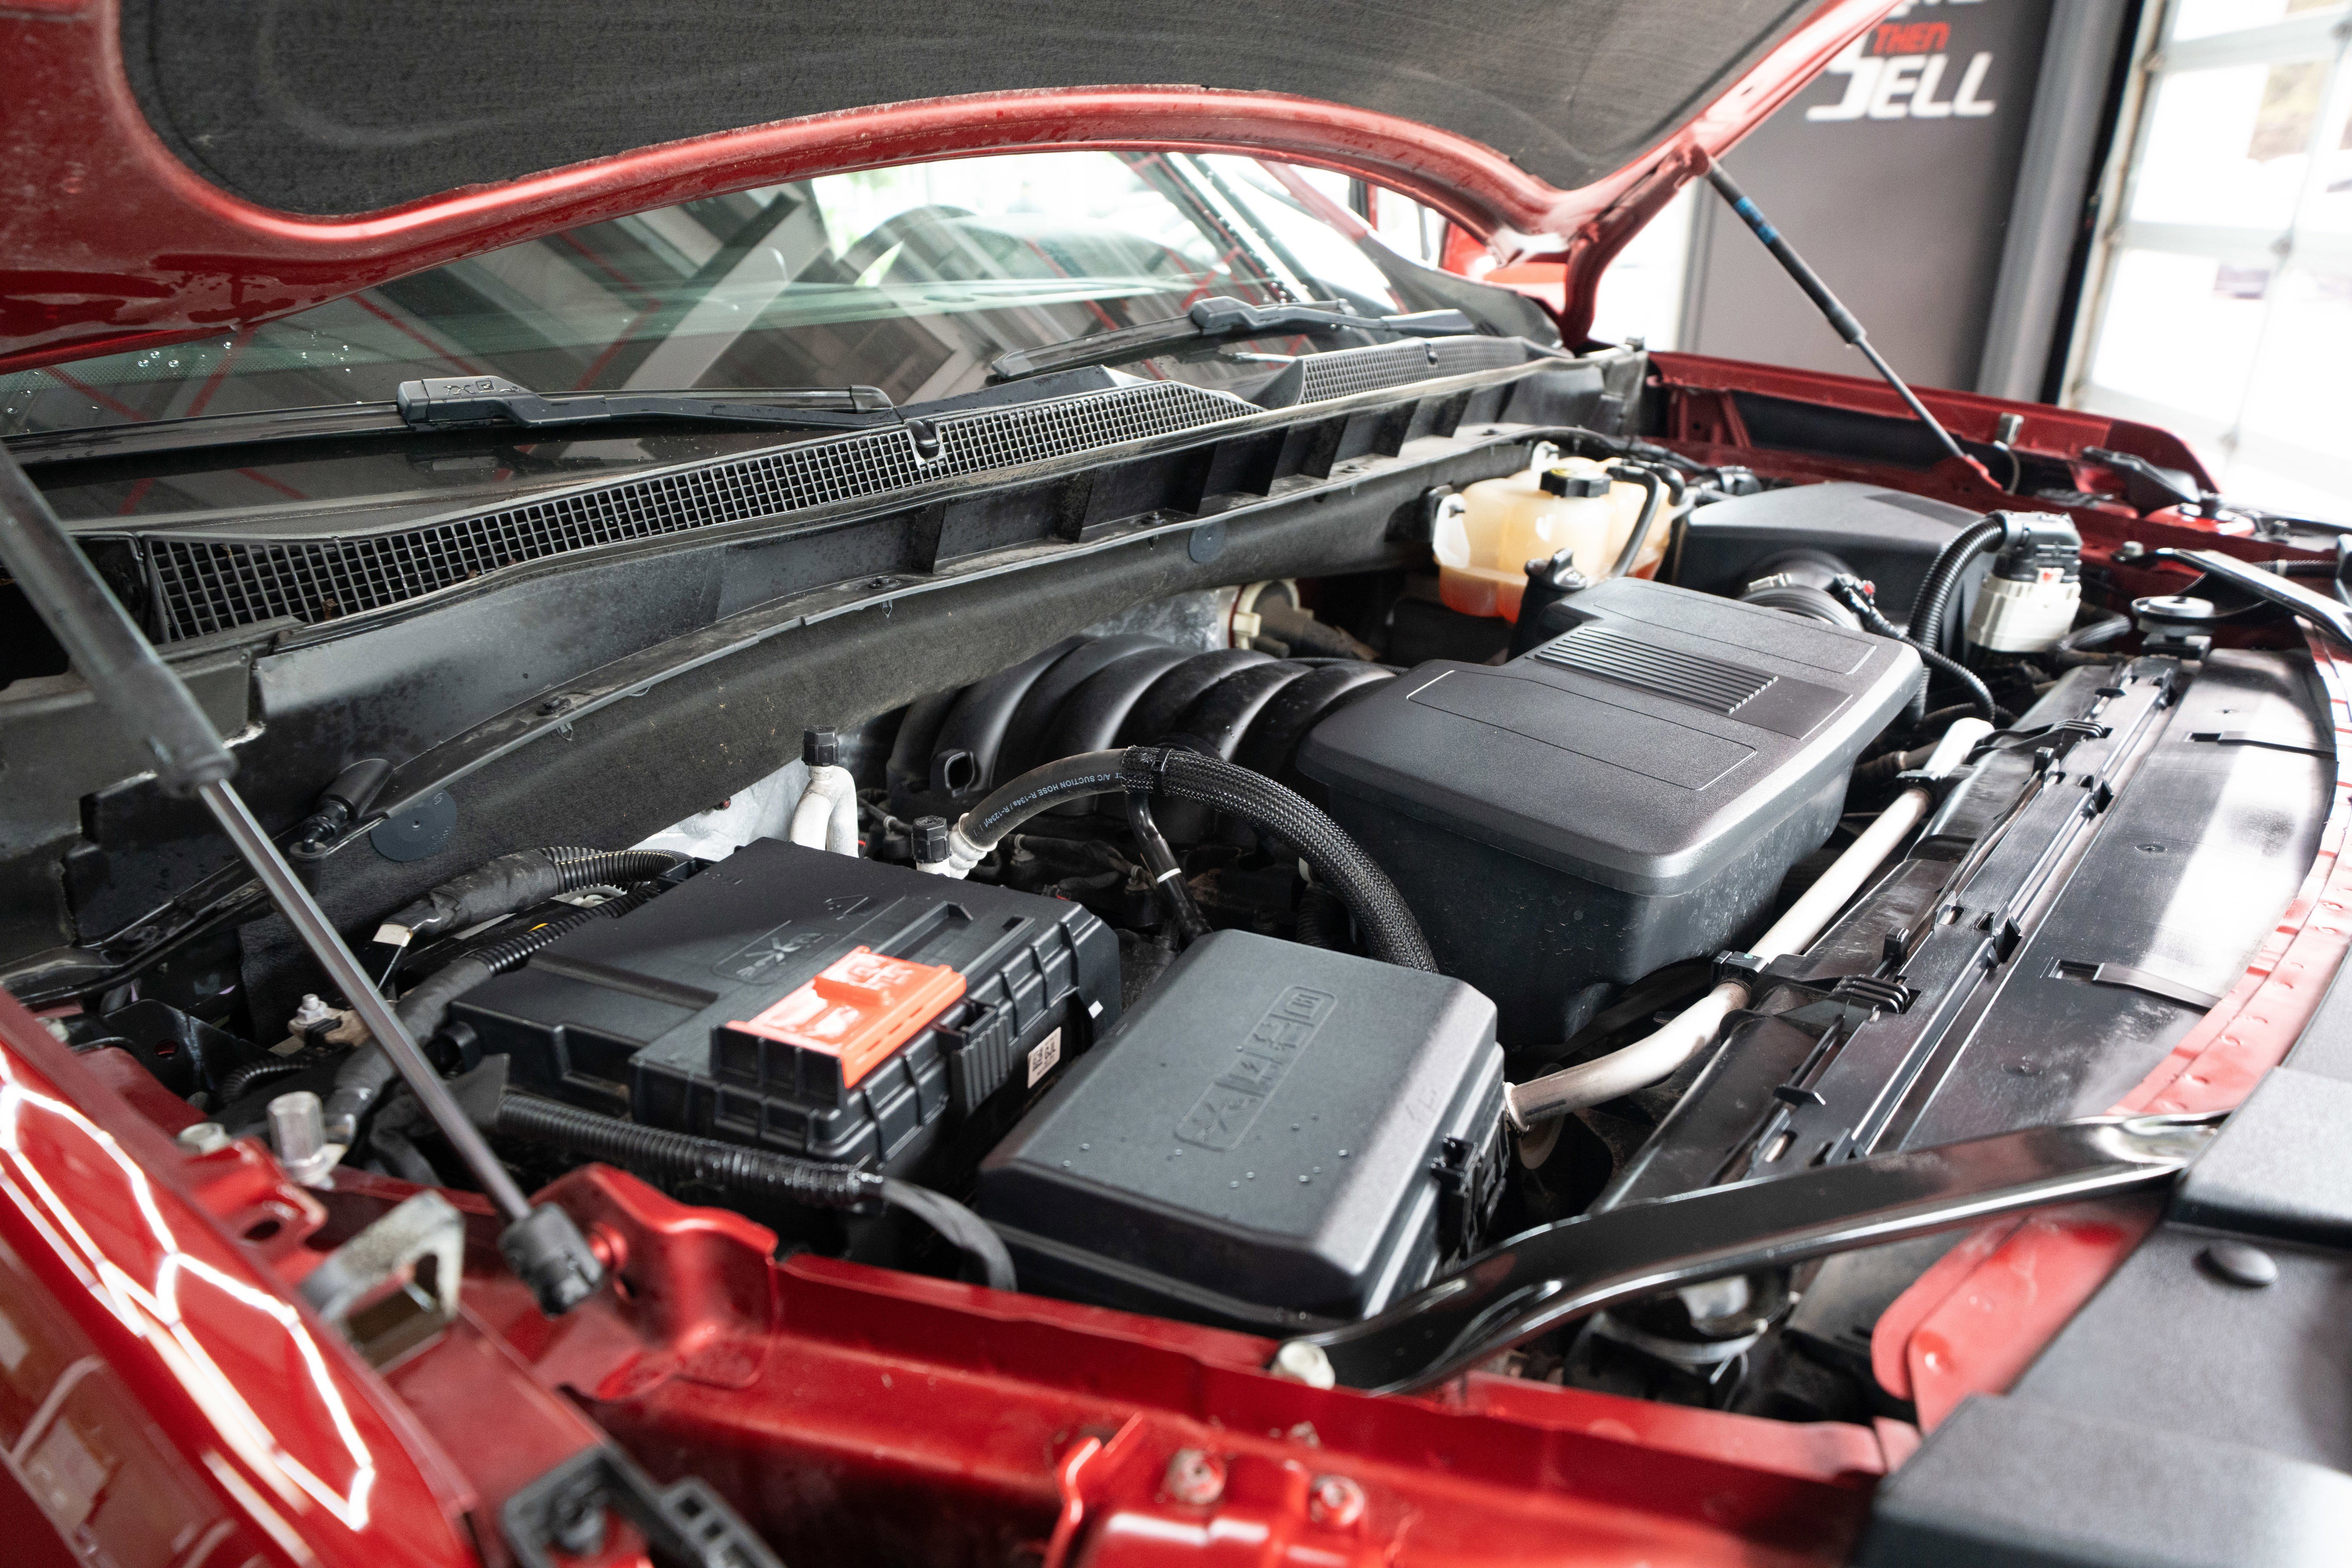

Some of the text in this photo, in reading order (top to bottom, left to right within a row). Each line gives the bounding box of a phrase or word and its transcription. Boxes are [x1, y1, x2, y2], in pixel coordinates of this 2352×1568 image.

[1060, 775, 1095, 788] SUCTION
[1037, 784, 1059, 796] HOSE
[1013, 792, 1037, 806] R-134a
[984, 806, 1010, 828] R-1234yf
